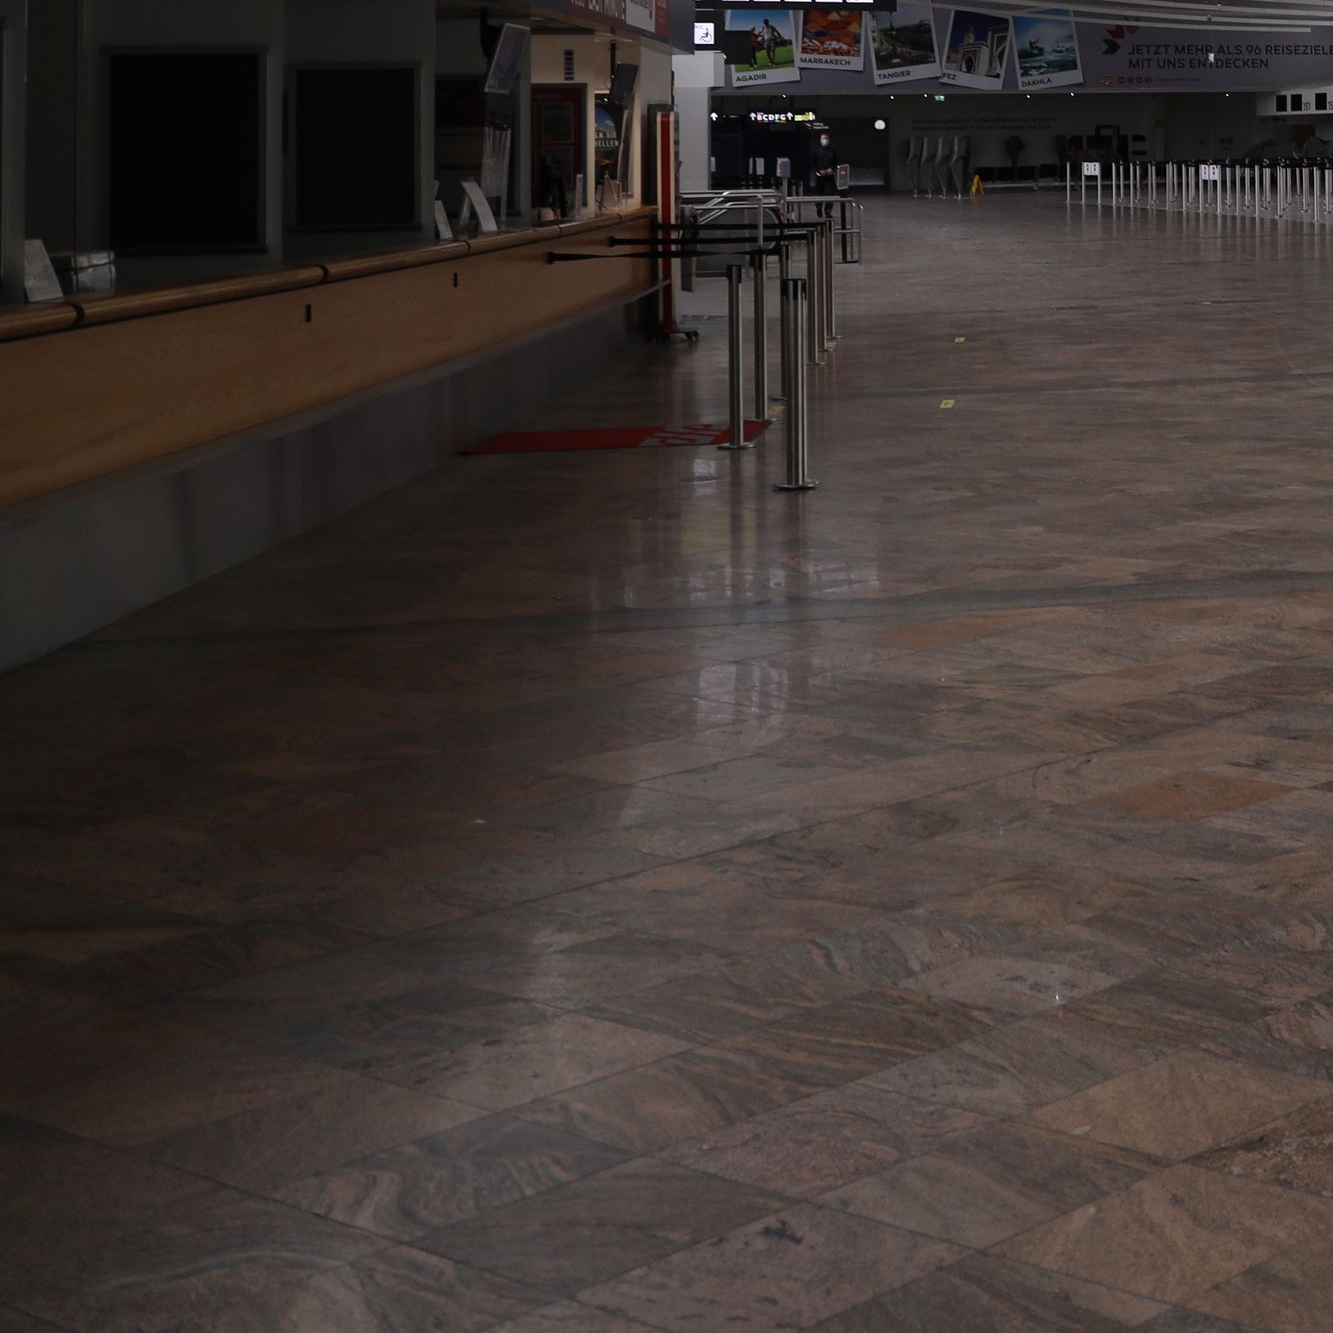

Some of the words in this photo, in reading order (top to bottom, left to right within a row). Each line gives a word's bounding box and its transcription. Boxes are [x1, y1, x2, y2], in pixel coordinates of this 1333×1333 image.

[1128, 44, 1170, 55] JETZT
[1175, 44, 1213, 55] MEHR
[1217, 44, 1242, 55] ALS
[1247, 45, 1262, 55] 96
[800, 57, 850, 66] MARRAKECH
[1129, 59, 1154, 68] MIT
[1157, 59, 1184, 68] UNS
[736, 74, 767, 83] AGADIR
[878, 70, 911, 80] TANGIER
[942, 72, 956, 80] FEZ
[1021, 78, 1052, 87] DAKHLA
